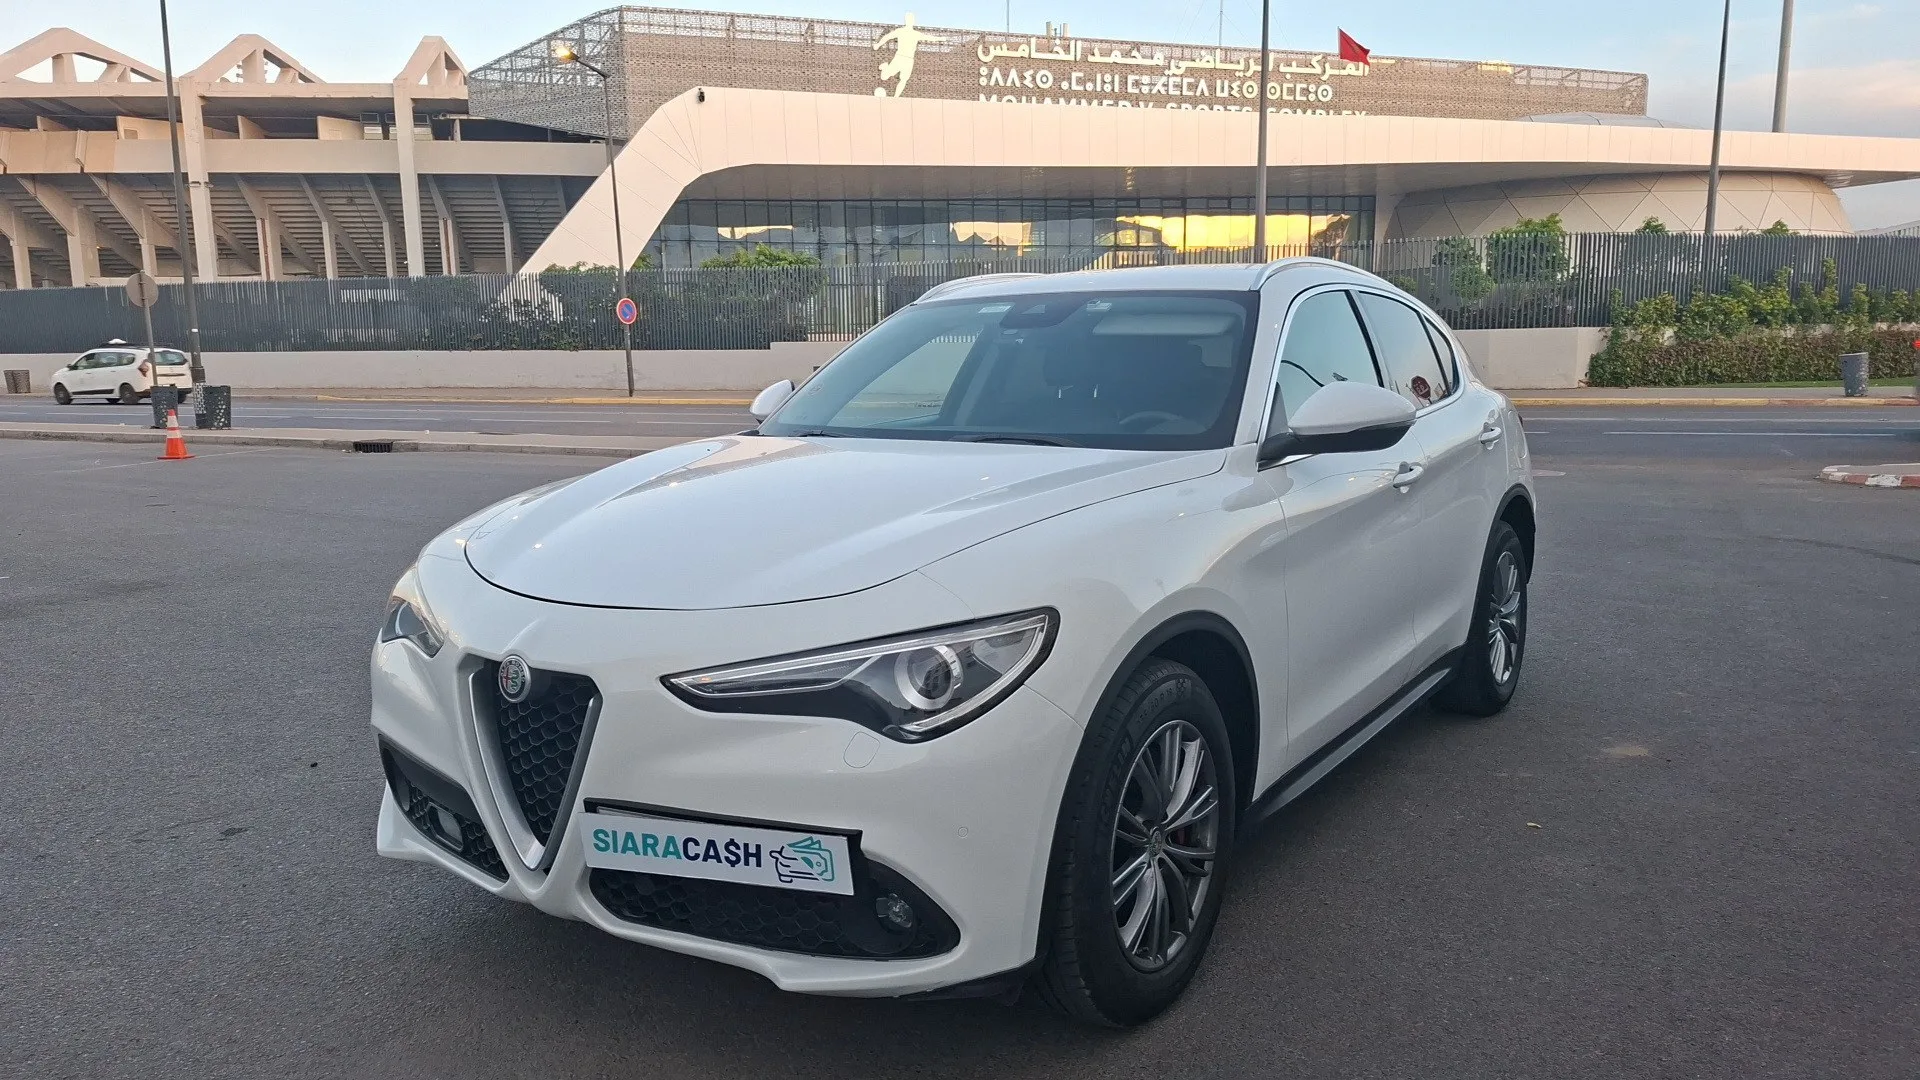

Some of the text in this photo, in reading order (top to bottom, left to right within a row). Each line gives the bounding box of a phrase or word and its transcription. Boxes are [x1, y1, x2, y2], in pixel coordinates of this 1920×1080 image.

[977, 37, 1081, 63] الخامس
[1087, 46, 1165, 67] محمد
[592, 828, 762, 868] SIARACA$H
